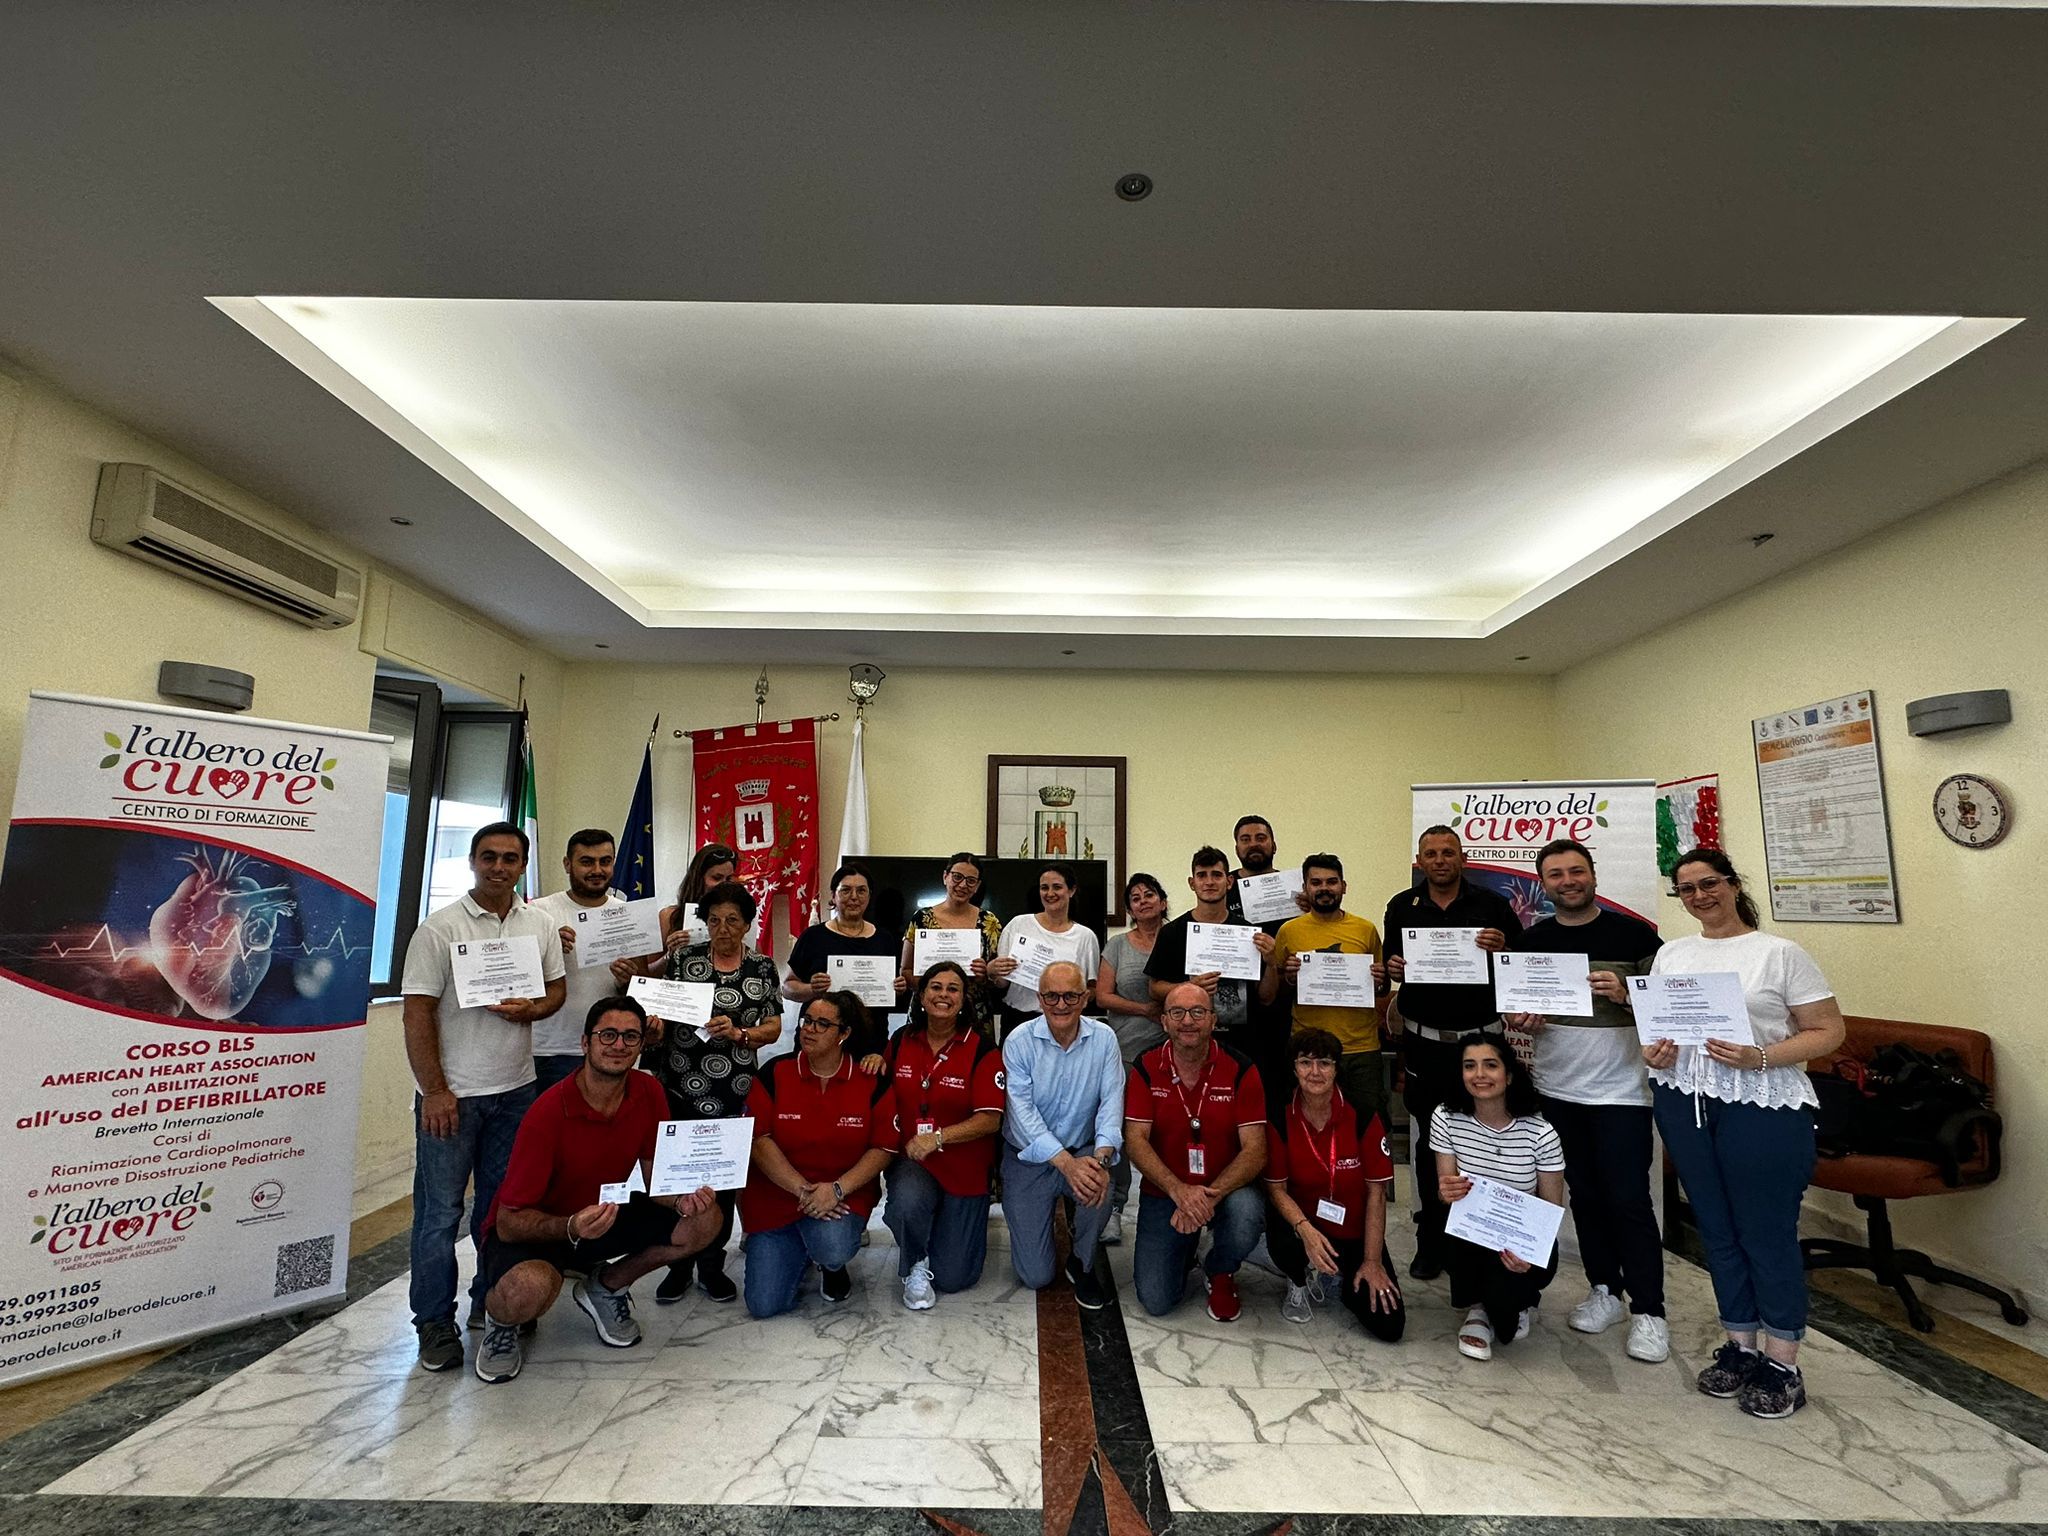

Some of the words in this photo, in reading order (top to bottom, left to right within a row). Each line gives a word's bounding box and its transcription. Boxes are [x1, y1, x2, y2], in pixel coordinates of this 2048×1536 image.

[272, 743, 324, 773] del
[1955, 780, 1969, 791] 12
[122, 803, 189, 820] CENTRO
[194, 809, 210, 821] DI
[215, 810, 310, 828] FORMAZIONE
[1556, 792, 1596, 816] del
[1939, 807, 1946, 818] 9
[1990, 805, 1999, 816] 3
[1969, 832, 1977, 843] 6
[1466, 849, 1506, 859] CENTRO
[1508, 849, 1519, 859] DI
[125, 1039, 211, 1061] CORSO
[218, 1036, 256, 1054] BLS
[40, 1066, 144, 1087] AMERICAN
[149, 1061, 206, 1078] HEART
[210, 1051, 316, 1072] ASSOCIATION
[111, 1085, 139, 1098] con
[143, 1072, 260, 1094] ABILITAZIONE
[110, 1099, 148, 1119] del
[156, 1081, 327, 1114] DEFIBRILLATORE
[94, 1120, 158, 1139] Brevetto
[162, 1107, 265, 1131] Internazionale
[153, 1130, 193, 1148] Corsi
[196, 1128, 211, 1142] di
[50, 1152, 162, 1178] Rianimazione
[166, 1134, 293, 1161] Cardiopolmonare
[27, 1187, 39, 1199] e
[44, 1176, 119, 1197] Manovre
[125, 1159, 227, 1185] Disostruzione
[231, 1146, 305, 1168] Pediatriche
[161, 1182, 204, 1208] del
[53, 1256, 72, 1267] SITO
[73, 1254, 84, 1263] DI
[85, 1244, 134, 1261] FORMAZIONE
[135, 1234, 186, 1250] AUTORIZZATO
[60, 1258, 101, 1273] AMERICAN
[103, 1253, 128, 1265] HEART
[128, 1243, 178, 1259] ASSOCIATION
[0, 1284, 217, 1345] mazione@lalberodelcuore.it
